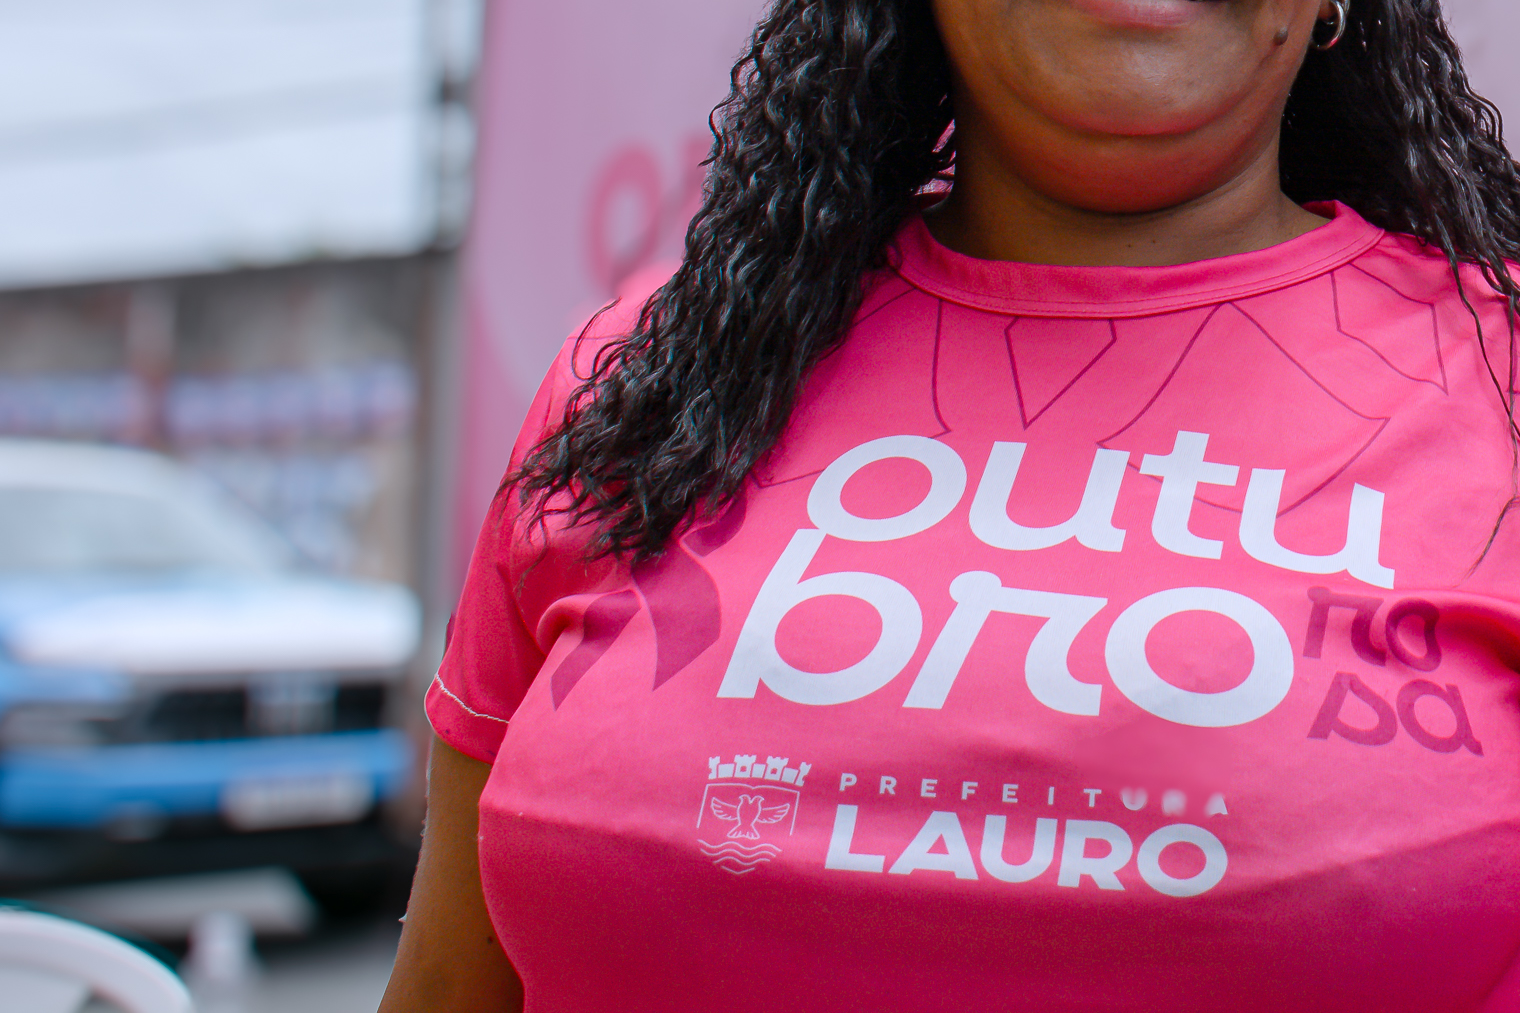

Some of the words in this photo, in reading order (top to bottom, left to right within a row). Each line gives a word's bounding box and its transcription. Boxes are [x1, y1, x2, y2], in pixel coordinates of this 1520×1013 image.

[807, 430, 1395, 589] outu
[717, 529, 1294, 728] bro
[825, 804, 1228, 898] LAURO
